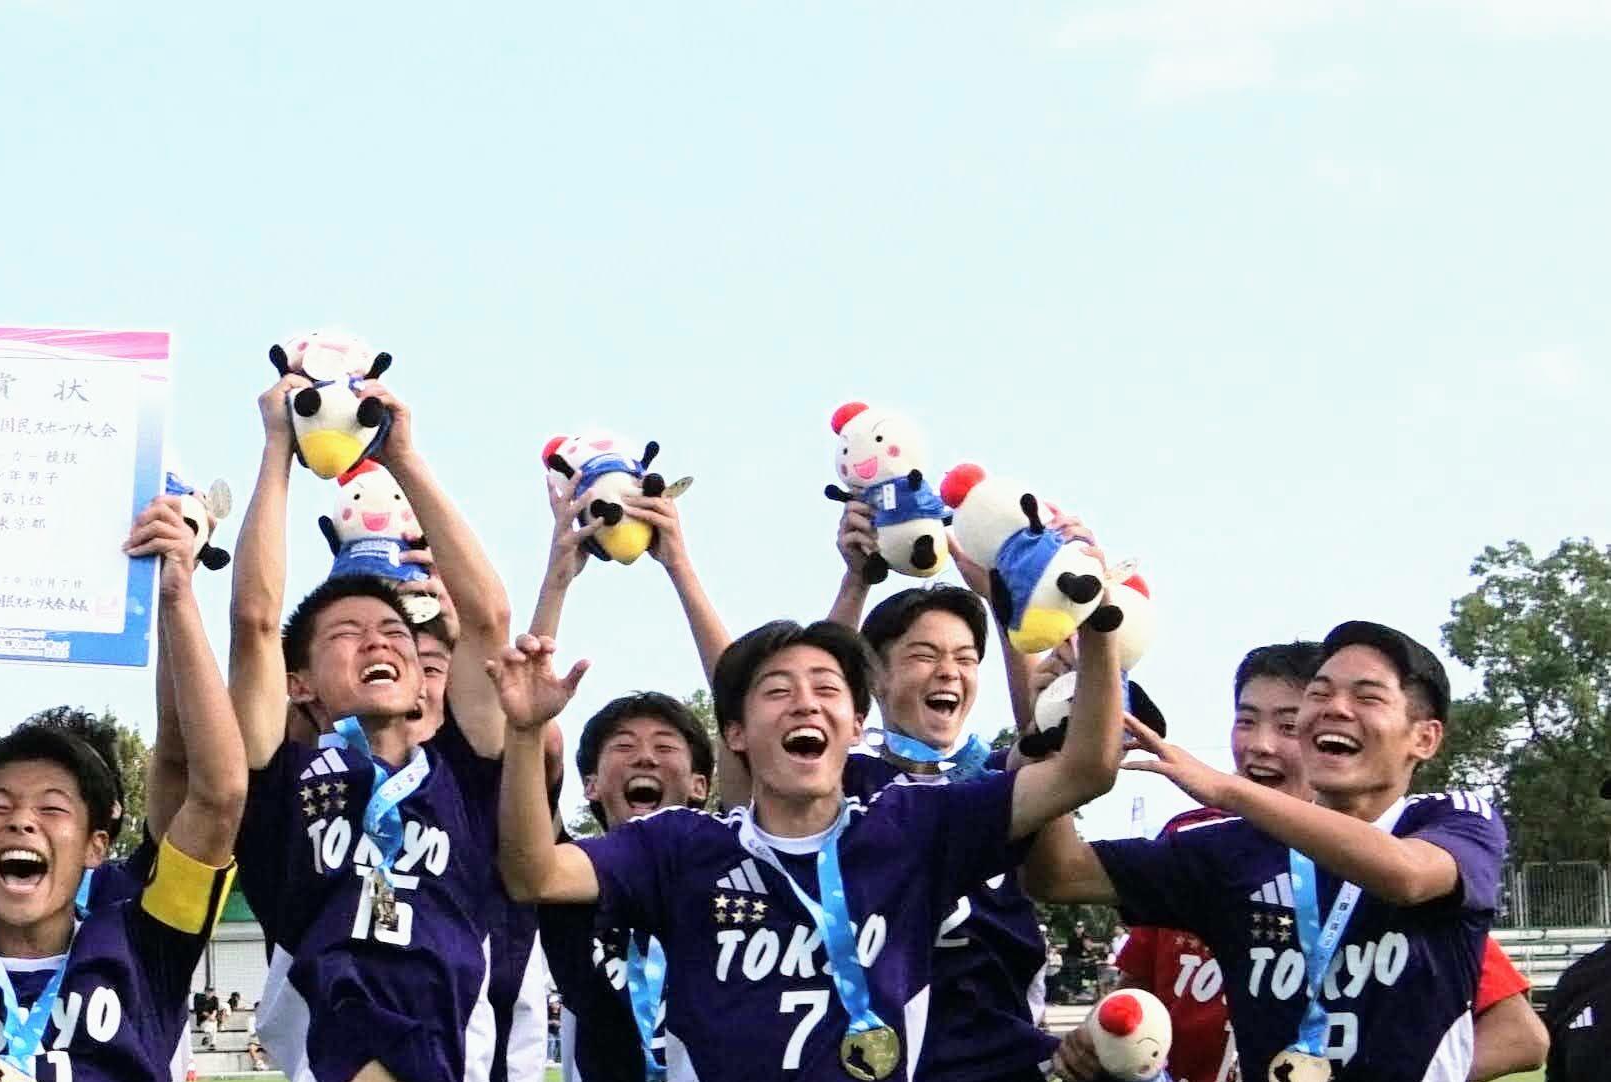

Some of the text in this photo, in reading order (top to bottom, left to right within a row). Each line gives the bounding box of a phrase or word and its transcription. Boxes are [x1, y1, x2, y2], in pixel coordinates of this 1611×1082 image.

[716, 913, 887, 982] TOKO
[1173, 953, 1228, 1006] TO
[780, 990, 830, 1069] 7
